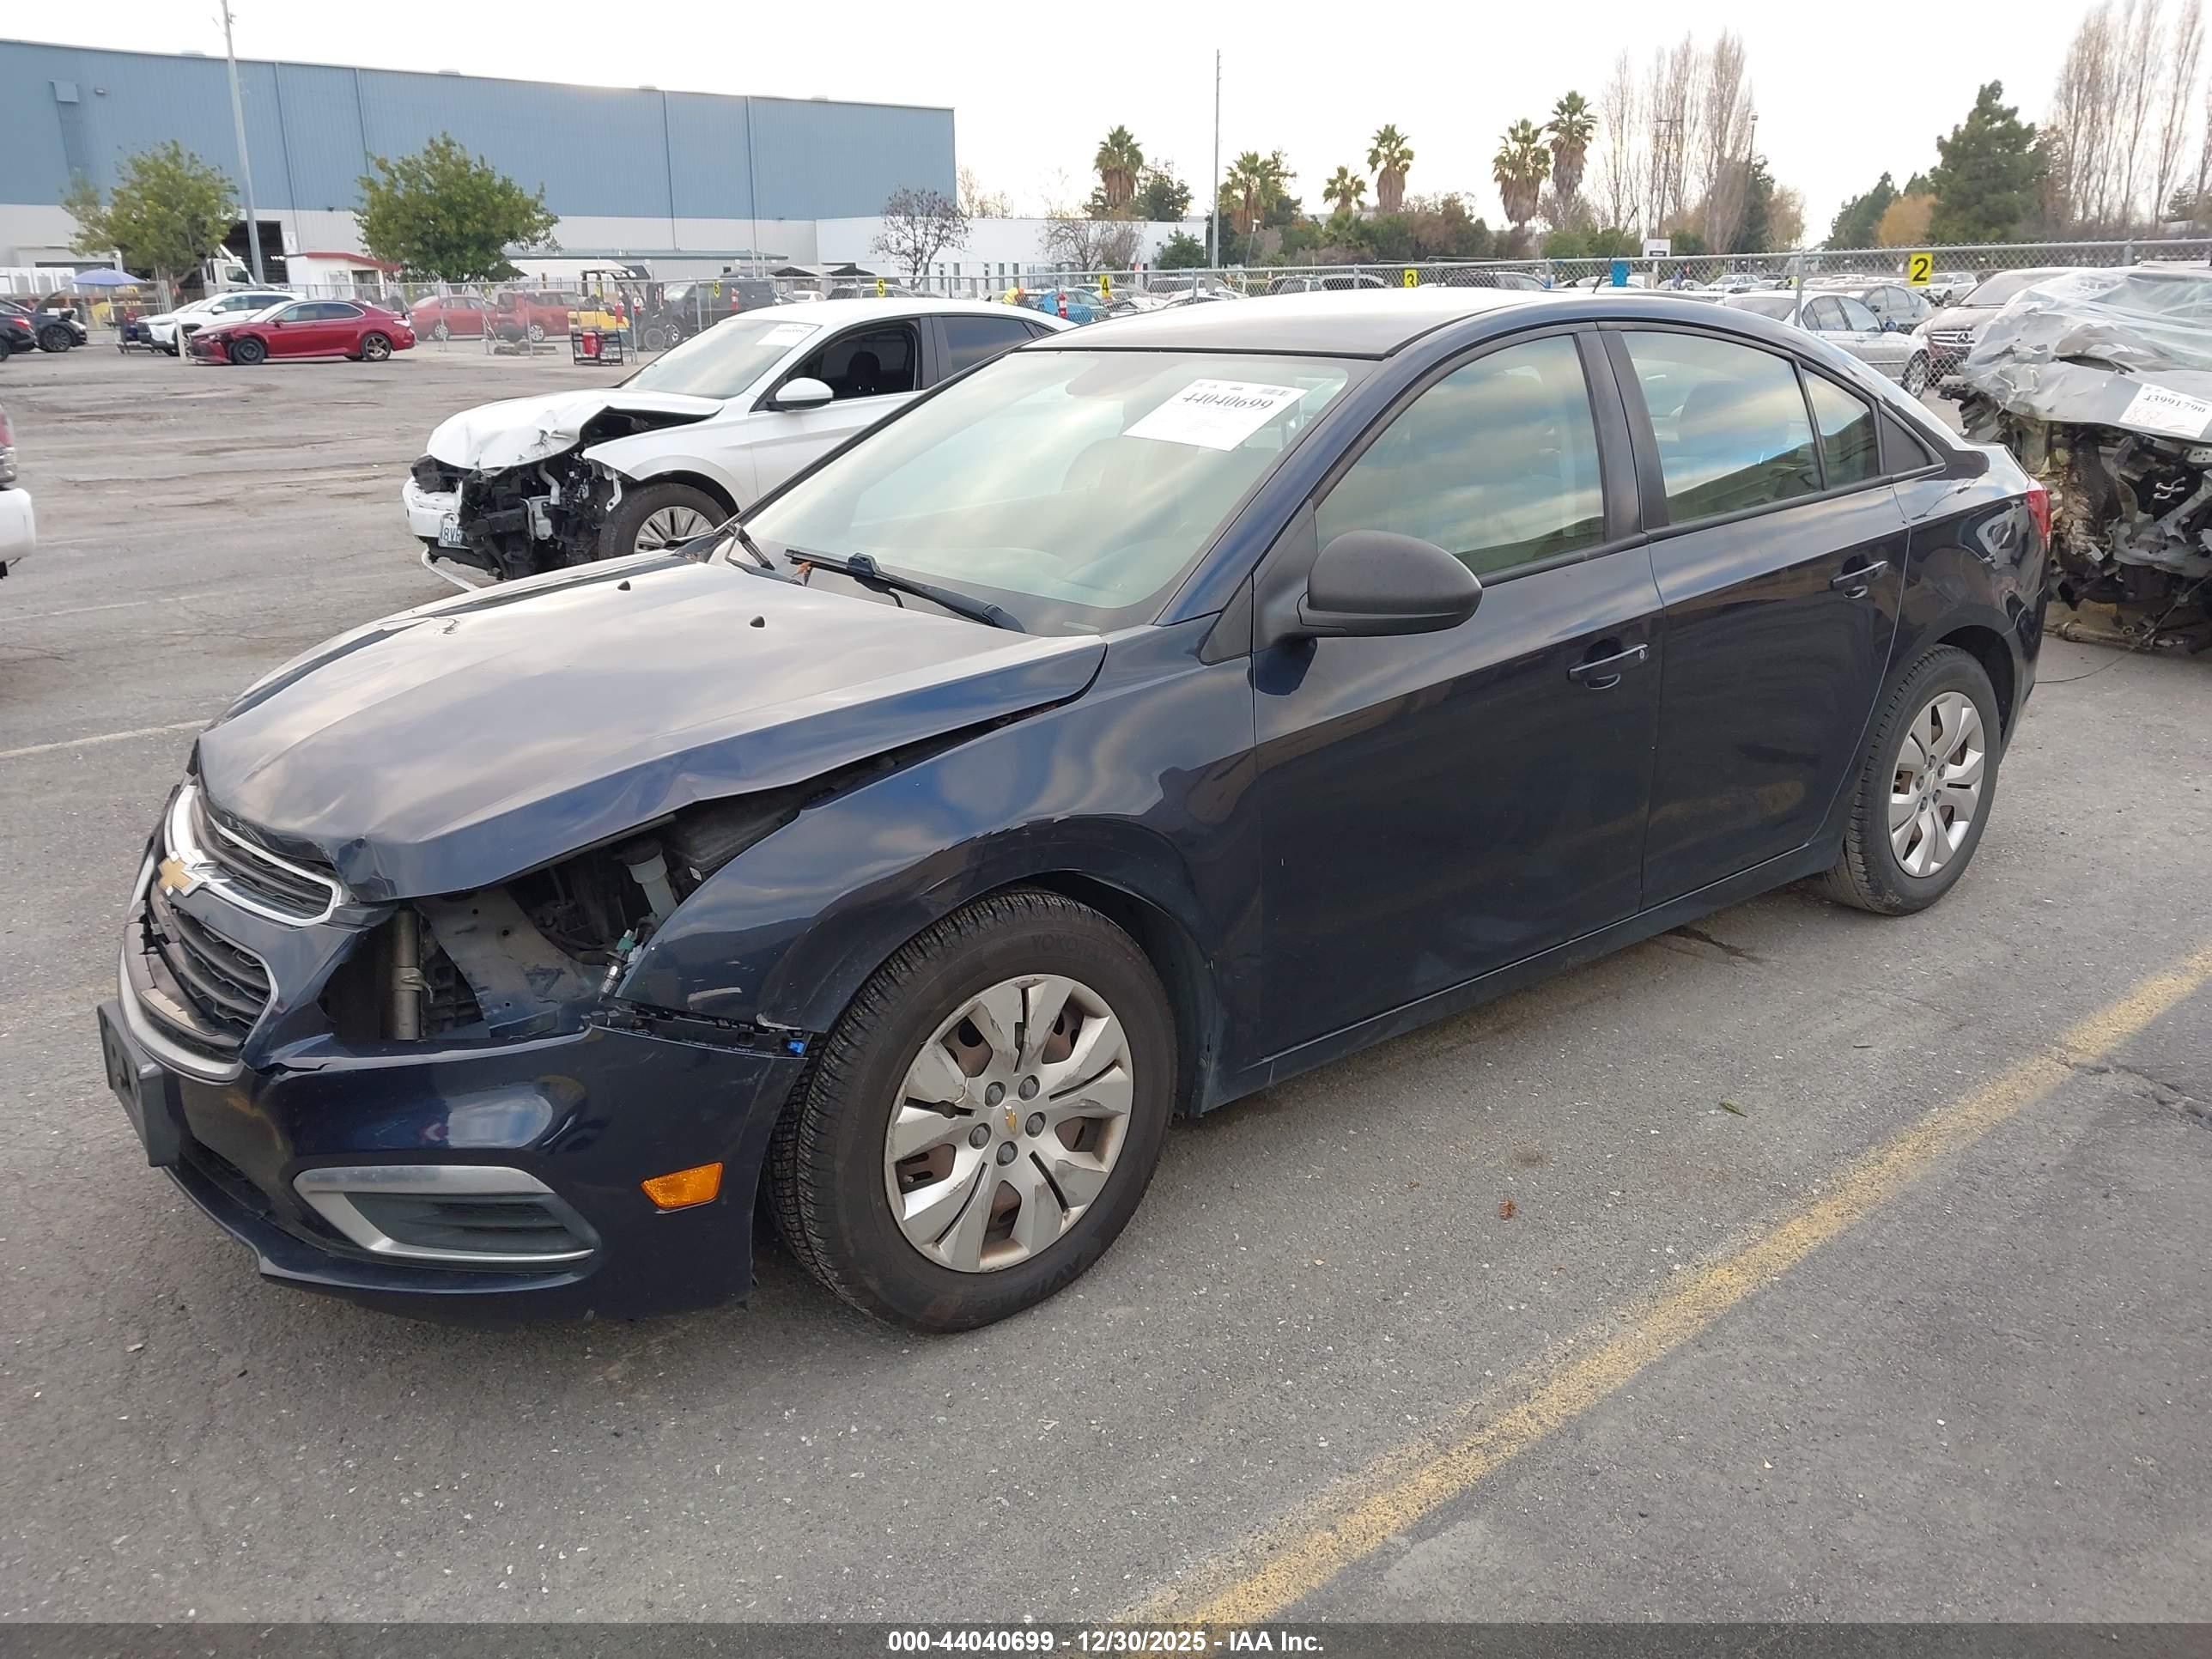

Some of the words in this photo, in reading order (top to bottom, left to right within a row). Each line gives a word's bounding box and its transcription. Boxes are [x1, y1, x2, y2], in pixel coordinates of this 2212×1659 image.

[1912, 257, 1929, 282] 2
[878, 280, 884, 295] 5
[1102, 277, 1109, 294] 4
[1407, 273, 1415, 288] 3
[1182, 392, 1274, 410] 44040699
